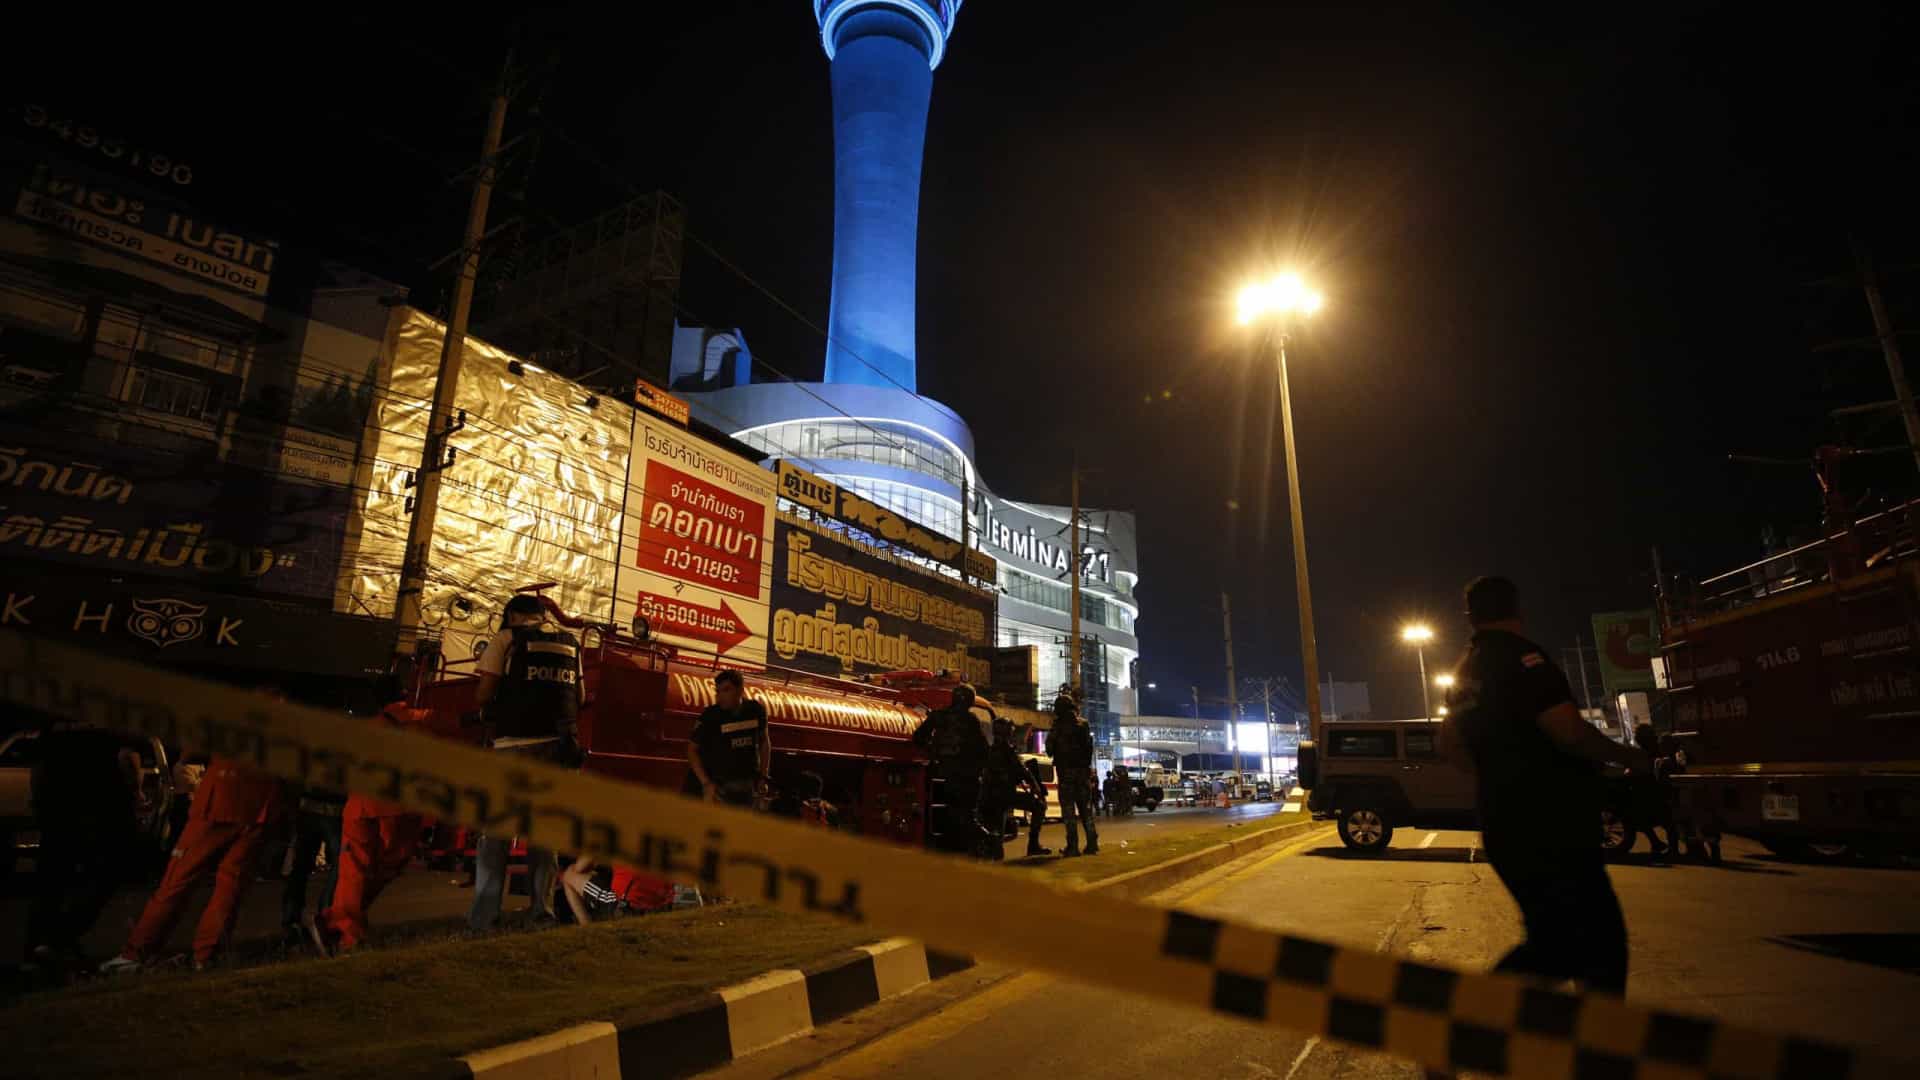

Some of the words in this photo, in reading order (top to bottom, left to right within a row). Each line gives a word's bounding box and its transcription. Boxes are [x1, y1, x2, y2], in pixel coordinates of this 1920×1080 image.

[649, 502, 757, 560] ดอกเบา
[663, 545, 741, 584] กว่าเยอะ
[666, 604, 698, 626] 500
[526, 664, 577, 684] POLICE
